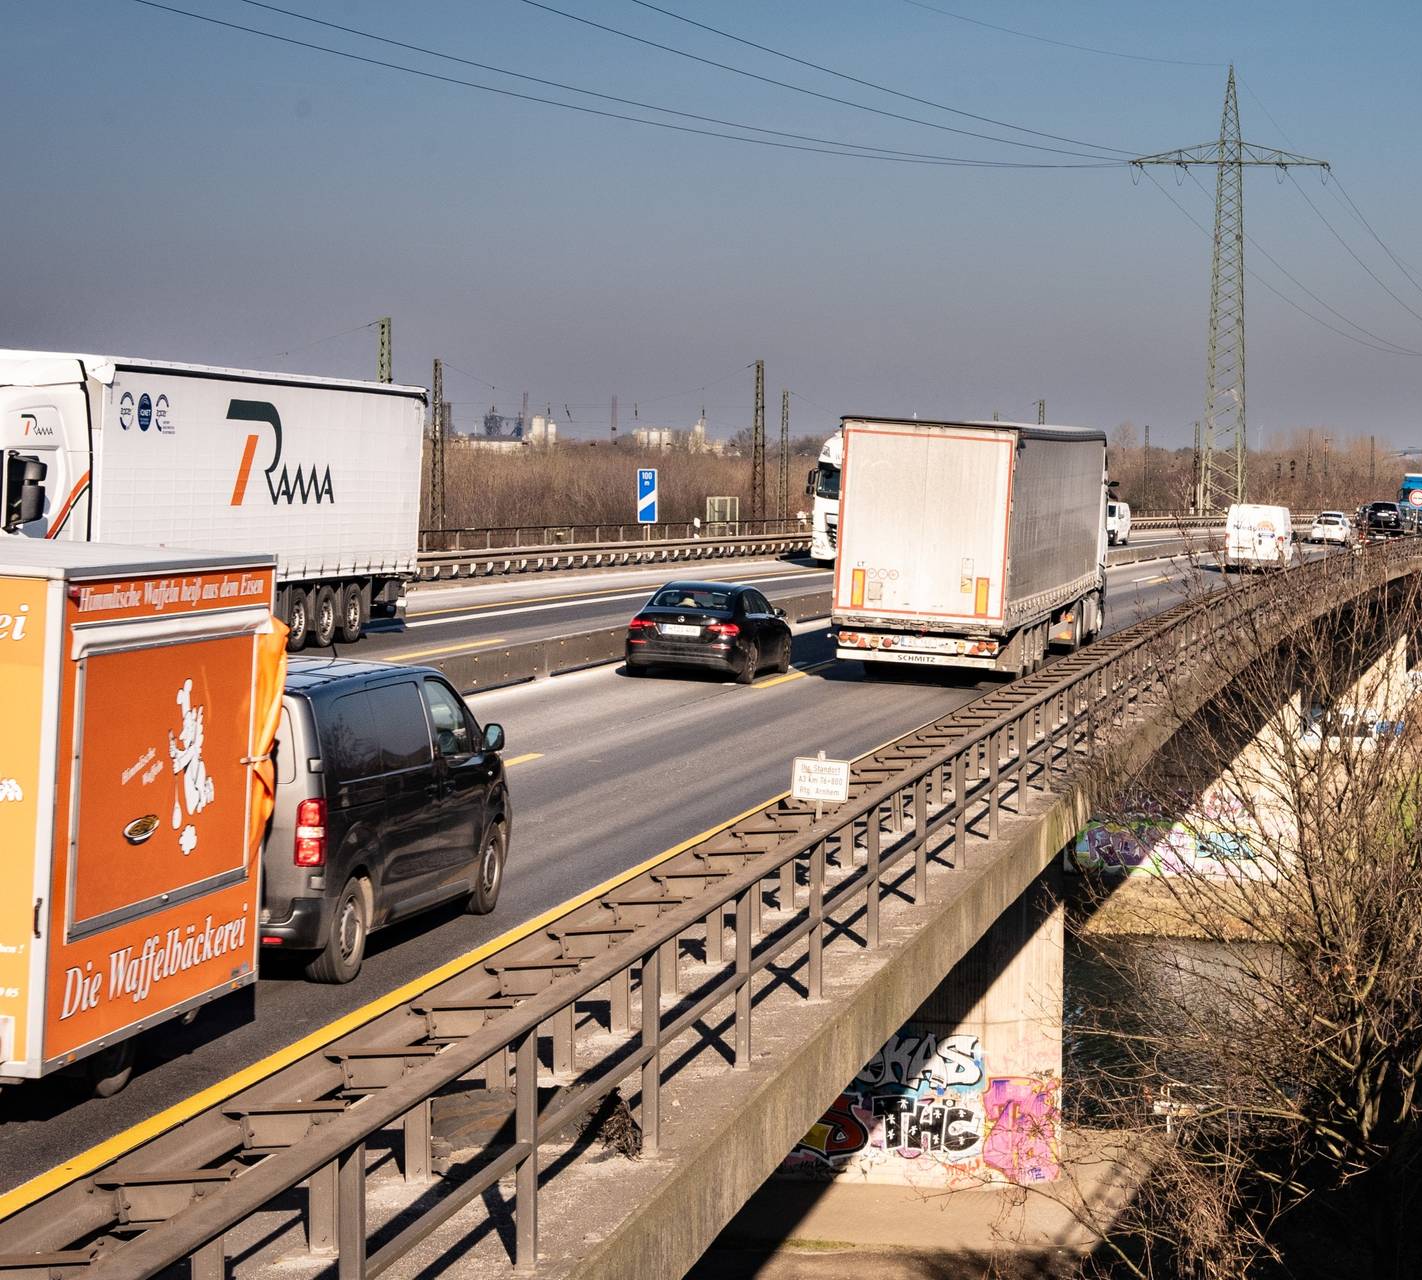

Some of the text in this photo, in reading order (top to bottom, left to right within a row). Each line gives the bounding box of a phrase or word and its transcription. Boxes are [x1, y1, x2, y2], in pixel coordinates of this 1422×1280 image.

[642, 471, 653, 480] 100
[78, 573, 264, 612] Himmlische Waffeln heiß aus dem Eisen
[897, 654, 936, 663] SCHMITZ
[59, 903, 248, 1021] Die Waffelbäckerei
